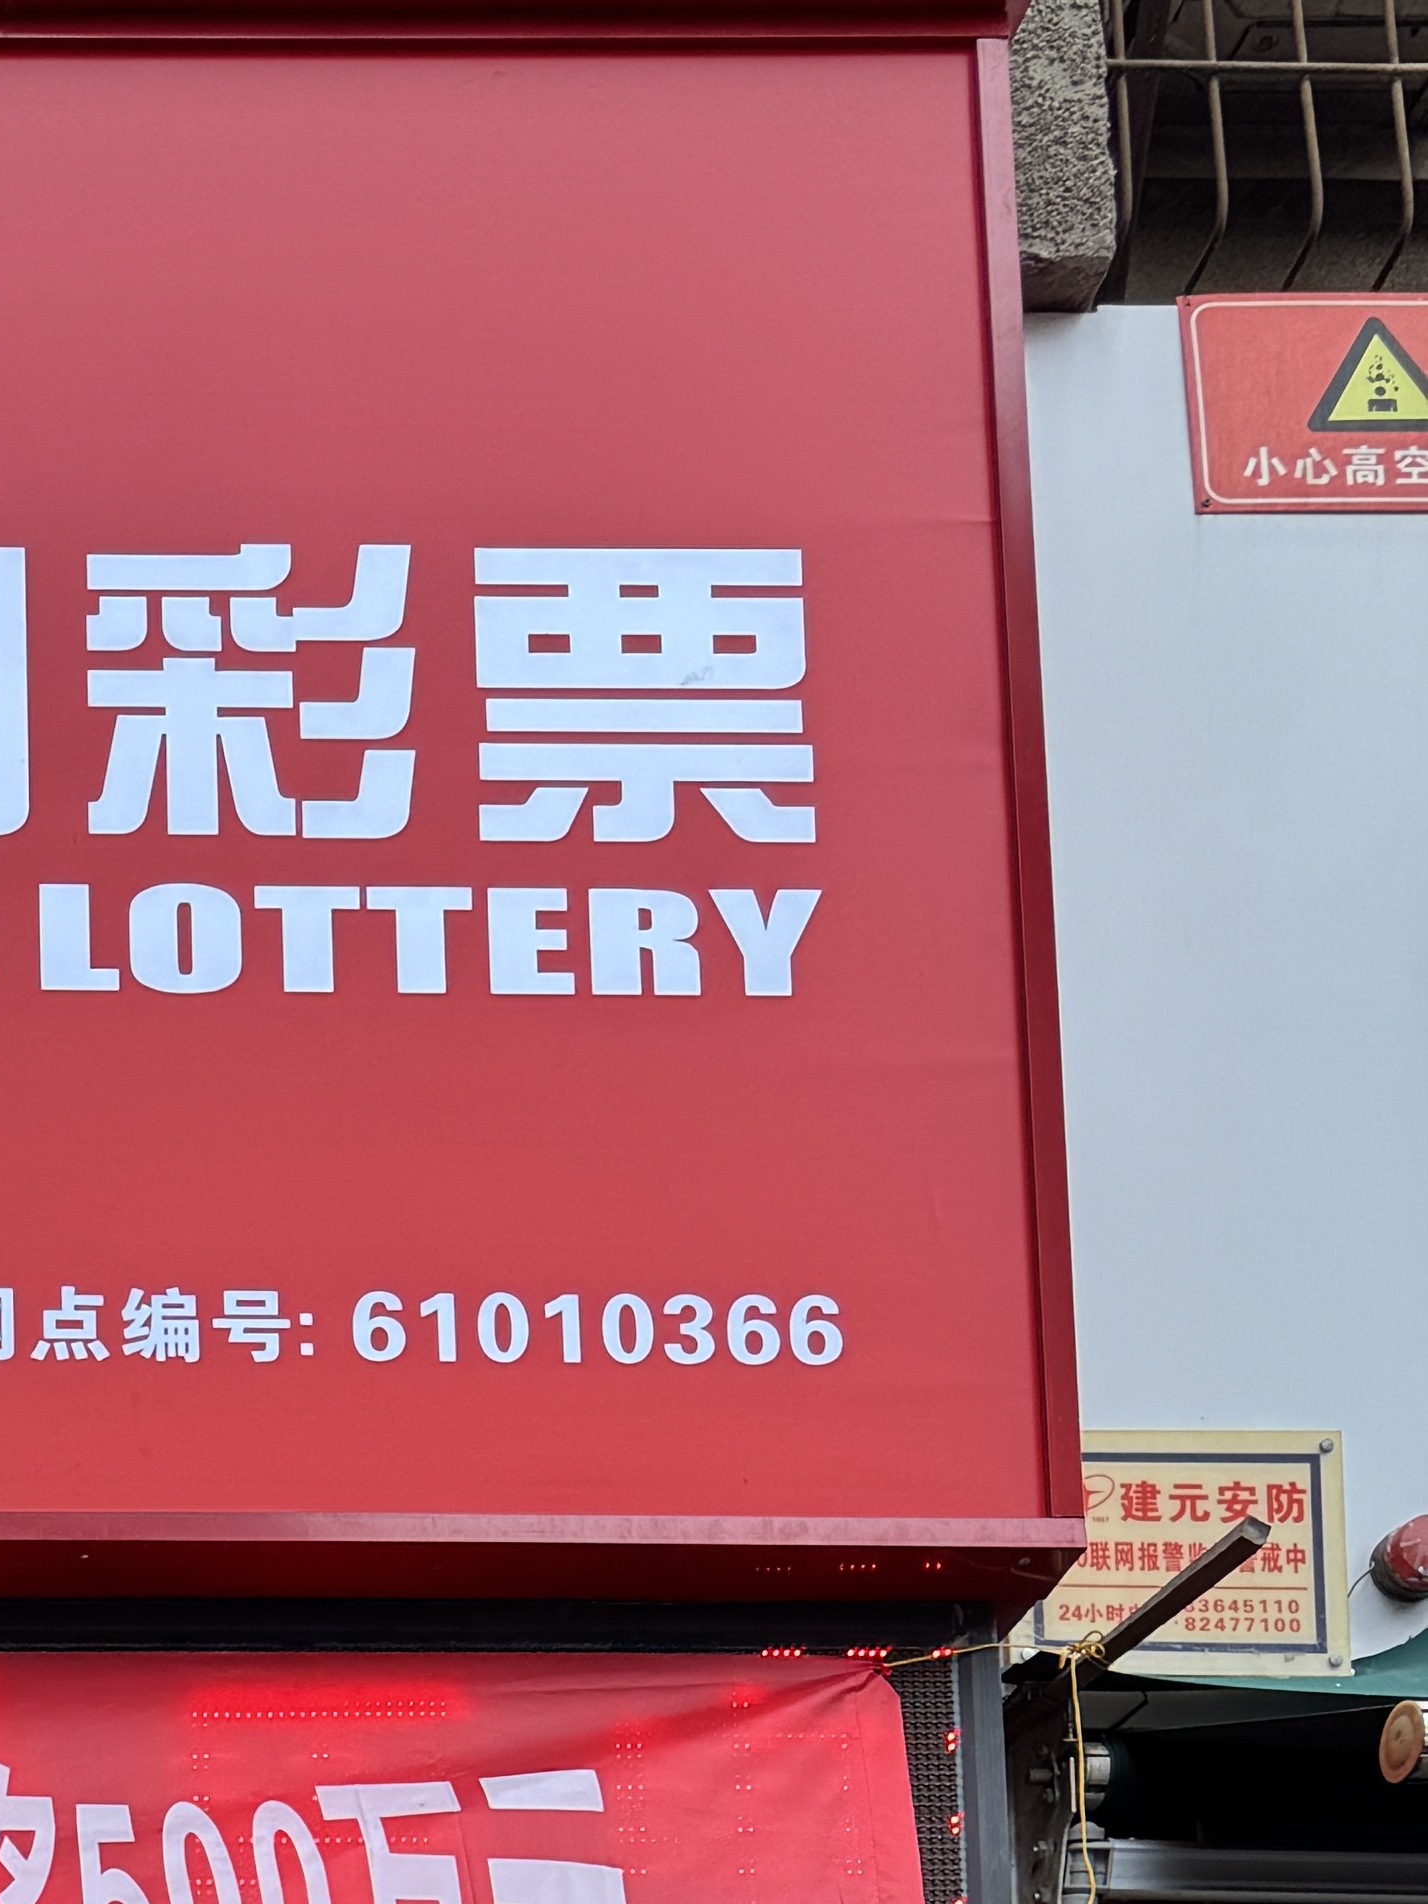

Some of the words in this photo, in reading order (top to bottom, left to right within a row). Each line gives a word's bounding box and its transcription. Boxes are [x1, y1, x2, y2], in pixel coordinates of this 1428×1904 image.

[1243, 445, 1428, 487] 小心高空
[38, 880, 825, 999] LOTTERY
[349, 1291, 846, 1369] 61010366
[1119, 1480, 1307, 1525] 建元安防
